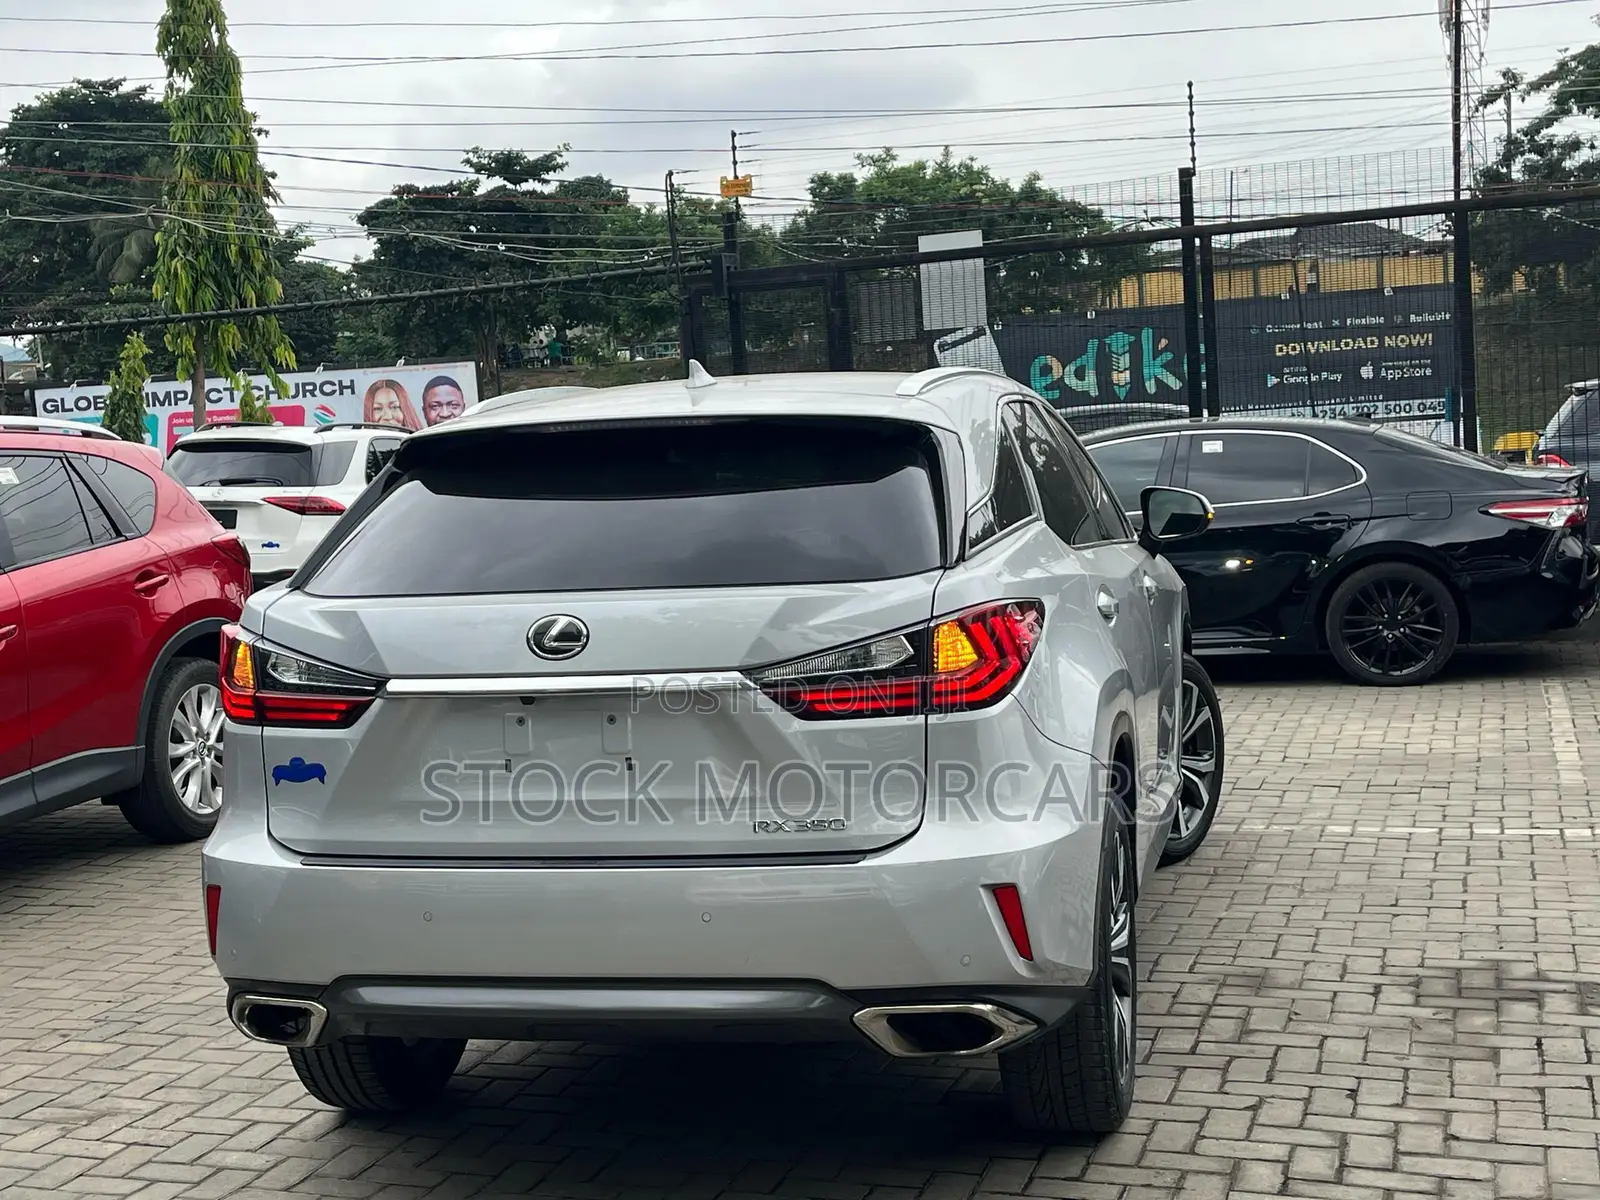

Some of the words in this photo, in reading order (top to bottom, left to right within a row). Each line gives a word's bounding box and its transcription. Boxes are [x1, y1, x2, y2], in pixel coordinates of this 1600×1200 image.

[1346, 315, 1385, 326] Flexible
[1409, 311, 1451, 323] Reliable
[1275, 336, 1379, 356] DOWNLOAD
[1384, 332, 1433, 348] NOW!
[1321, 371, 1343, 383] Play
[1379, 367, 1403, 381] App
[1403, 366, 1432, 378] Store
[42, 395, 110, 415] GLOB
[1384, 402, 1412, 415] 500
[1417, 400, 1445, 413] 049
